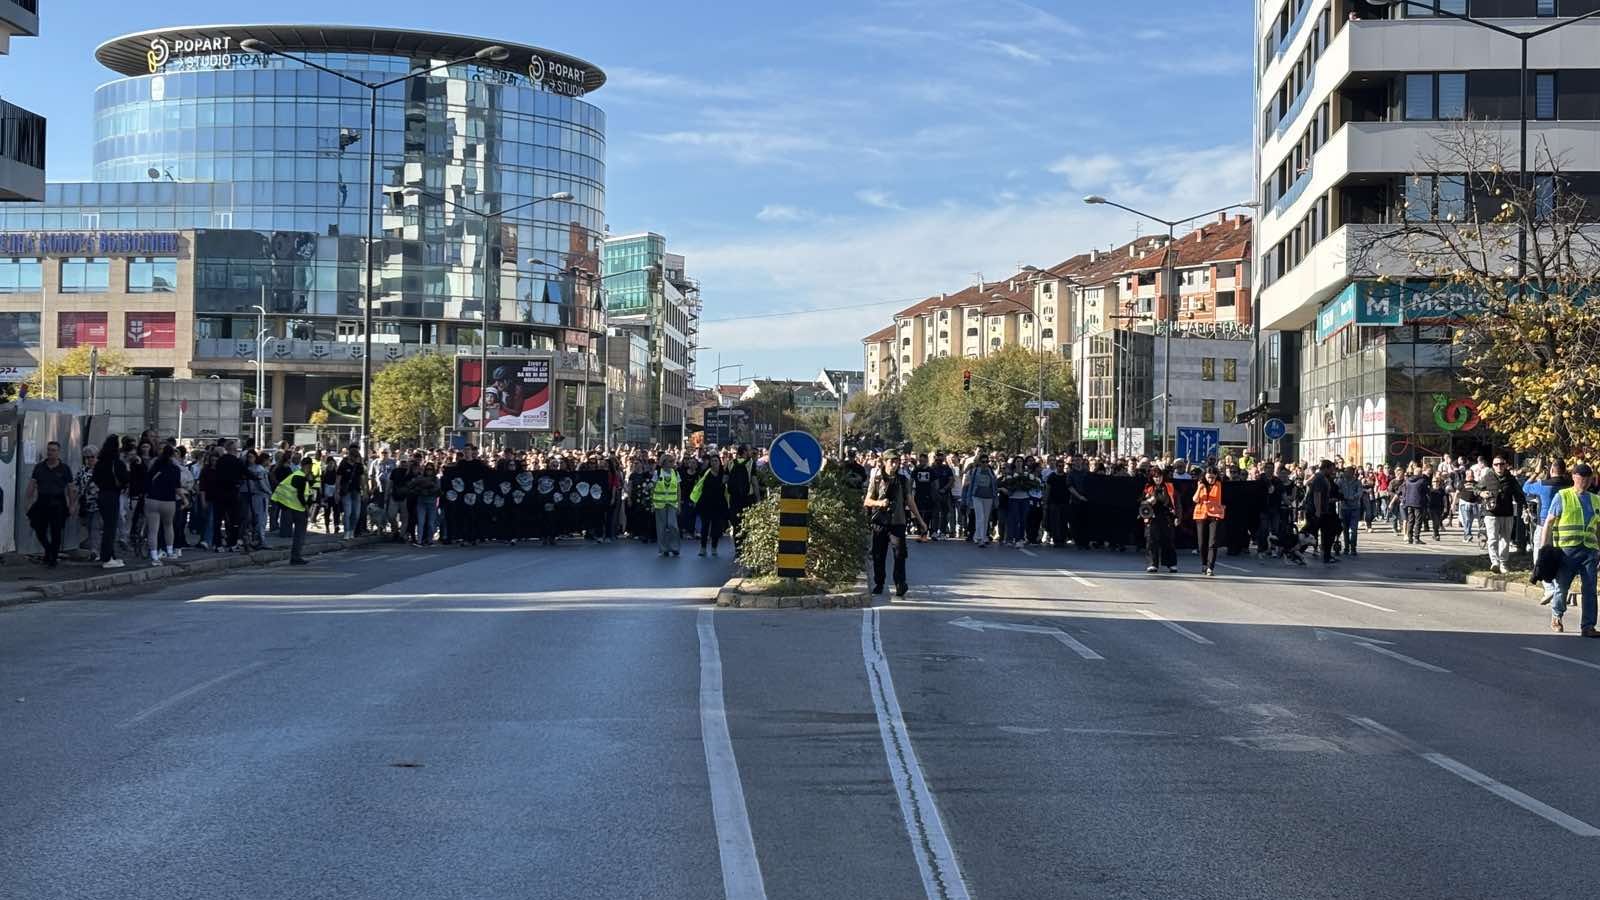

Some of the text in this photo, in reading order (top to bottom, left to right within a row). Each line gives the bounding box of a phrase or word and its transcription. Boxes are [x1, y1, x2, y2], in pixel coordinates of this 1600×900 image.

[175, 37, 231, 52] POPART
[187, 53, 231, 67] STUDIO
[549, 61, 585, 82] POPART
[557, 80, 585, 97] STUDIO
